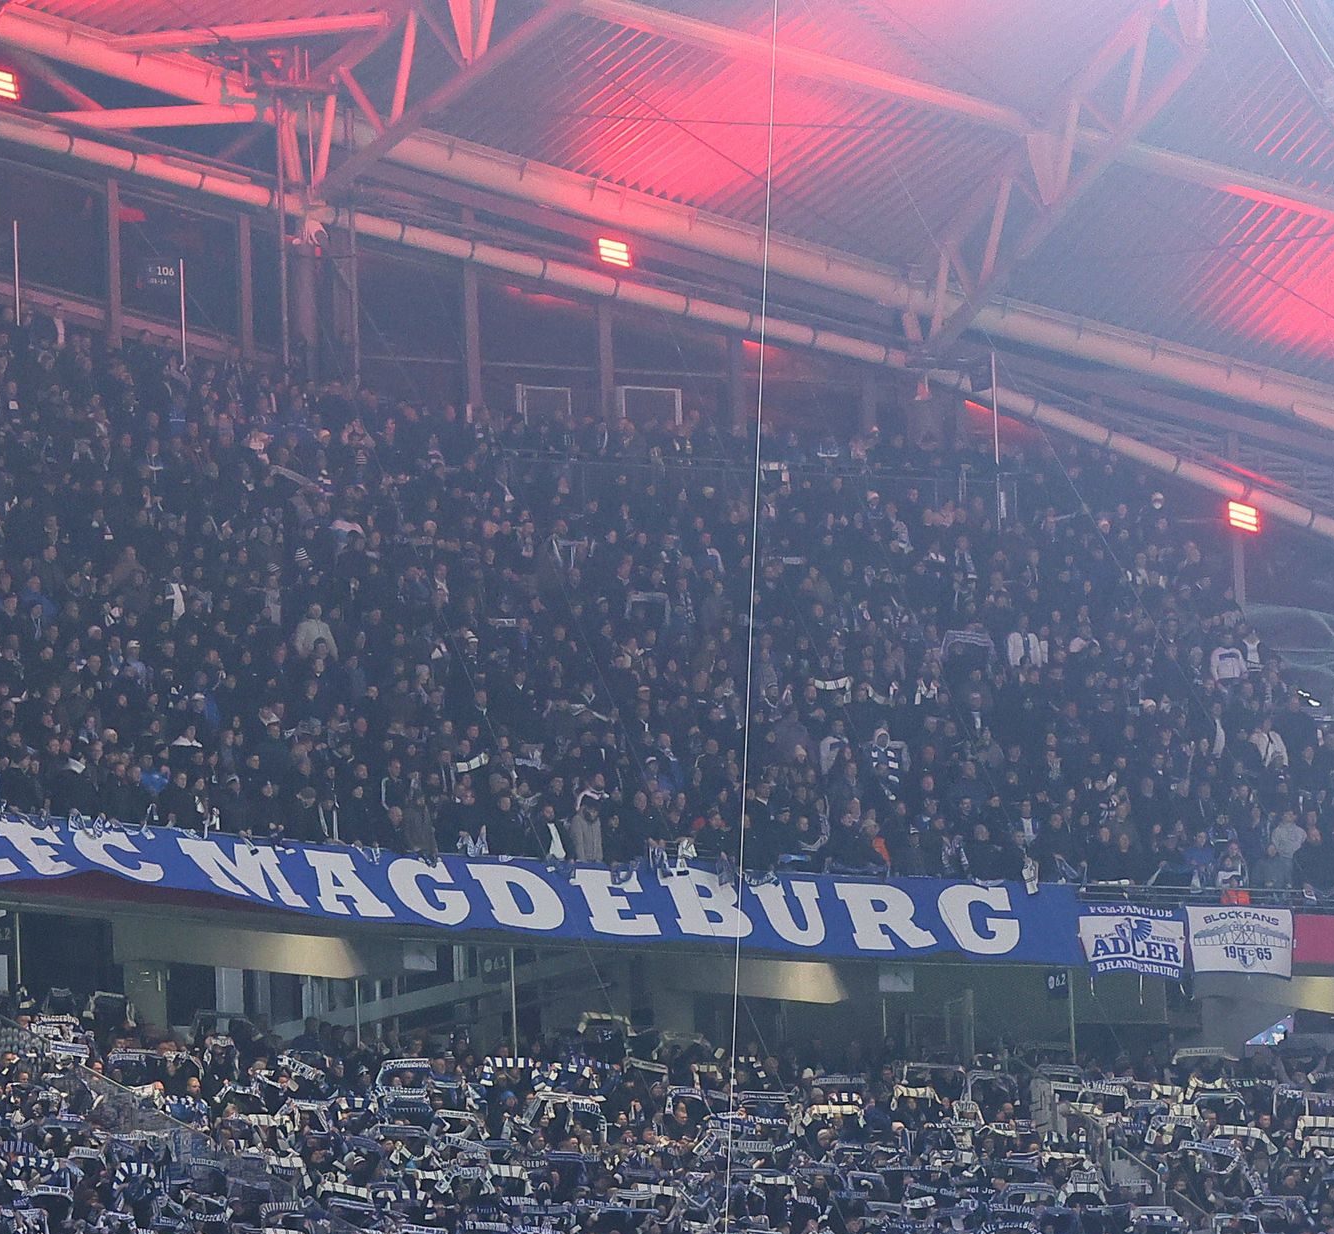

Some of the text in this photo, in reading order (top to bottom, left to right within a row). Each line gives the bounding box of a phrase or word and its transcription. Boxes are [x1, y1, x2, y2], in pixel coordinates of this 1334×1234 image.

[179, 836, 1022, 956] MAGDEBURG
[1203, 911, 1280, 926] BLOCKFANS
[1091, 935, 1183, 964] ADLER
[1223, 946, 1273, 961] 19 65
[1097, 961, 1180, 979] BRANDENBURG
